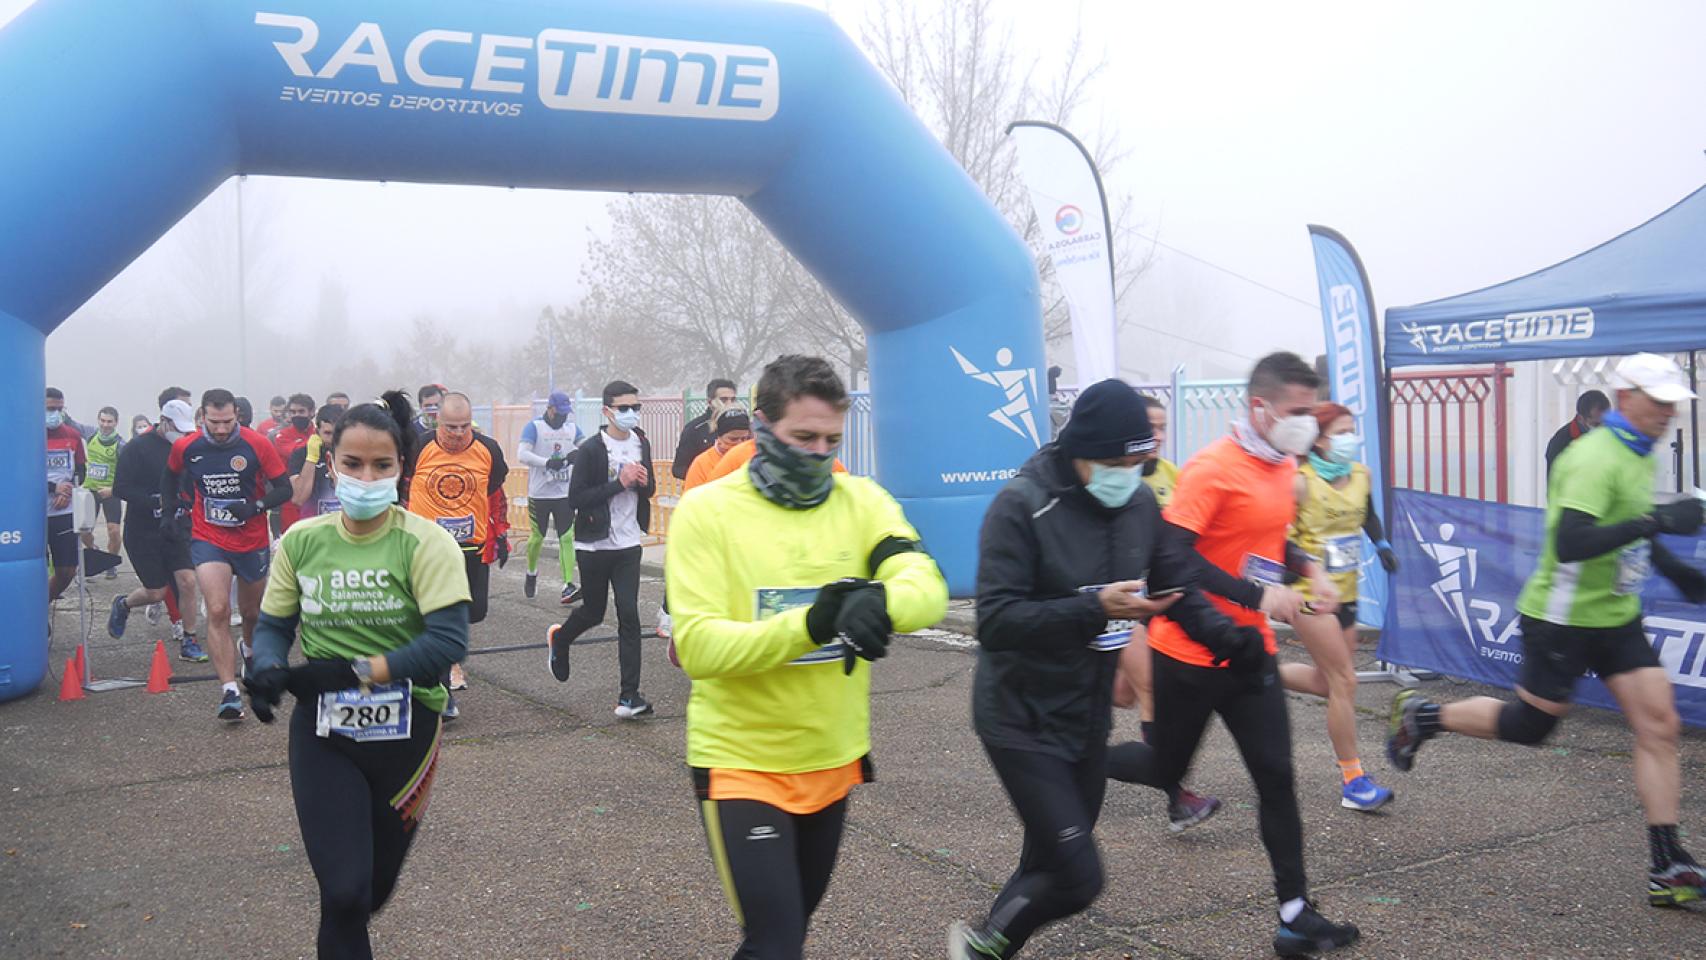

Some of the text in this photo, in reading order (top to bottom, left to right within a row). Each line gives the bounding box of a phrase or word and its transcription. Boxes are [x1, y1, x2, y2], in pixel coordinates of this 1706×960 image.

[280, 86, 523, 116] EVENTOS DEPORTIVOS
[941, 468, 1021, 484] www.rac
[331, 569, 390, 589] aecc
[331, 590, 384, 600] Salamanca
[1481, 646, 1524, 664] EVENTO
[340, 705, 391, 728] 280
